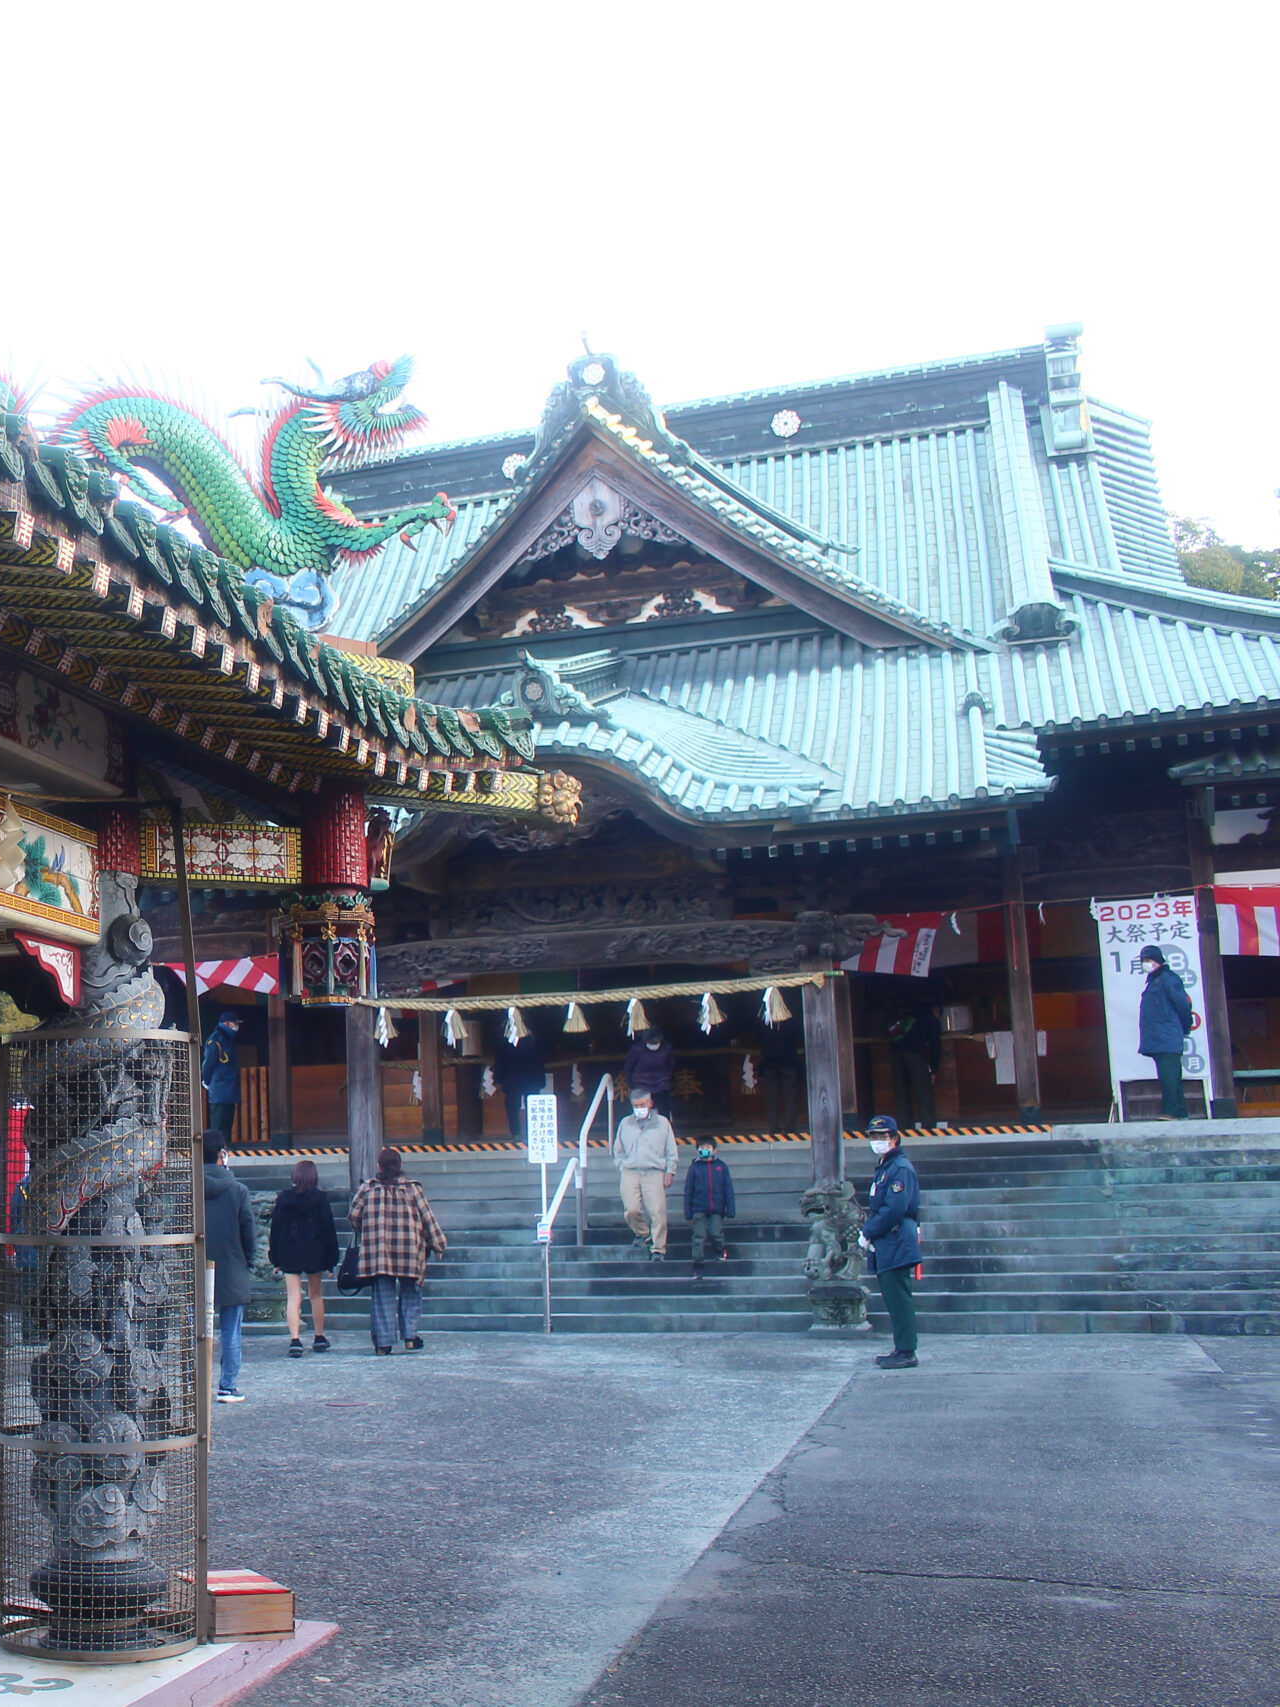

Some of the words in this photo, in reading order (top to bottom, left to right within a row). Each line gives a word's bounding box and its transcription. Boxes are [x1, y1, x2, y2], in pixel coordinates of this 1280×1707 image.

[1100, 900, 1193, 922] 2023年
[1106, 920, 1193, 944] 大祭予定
